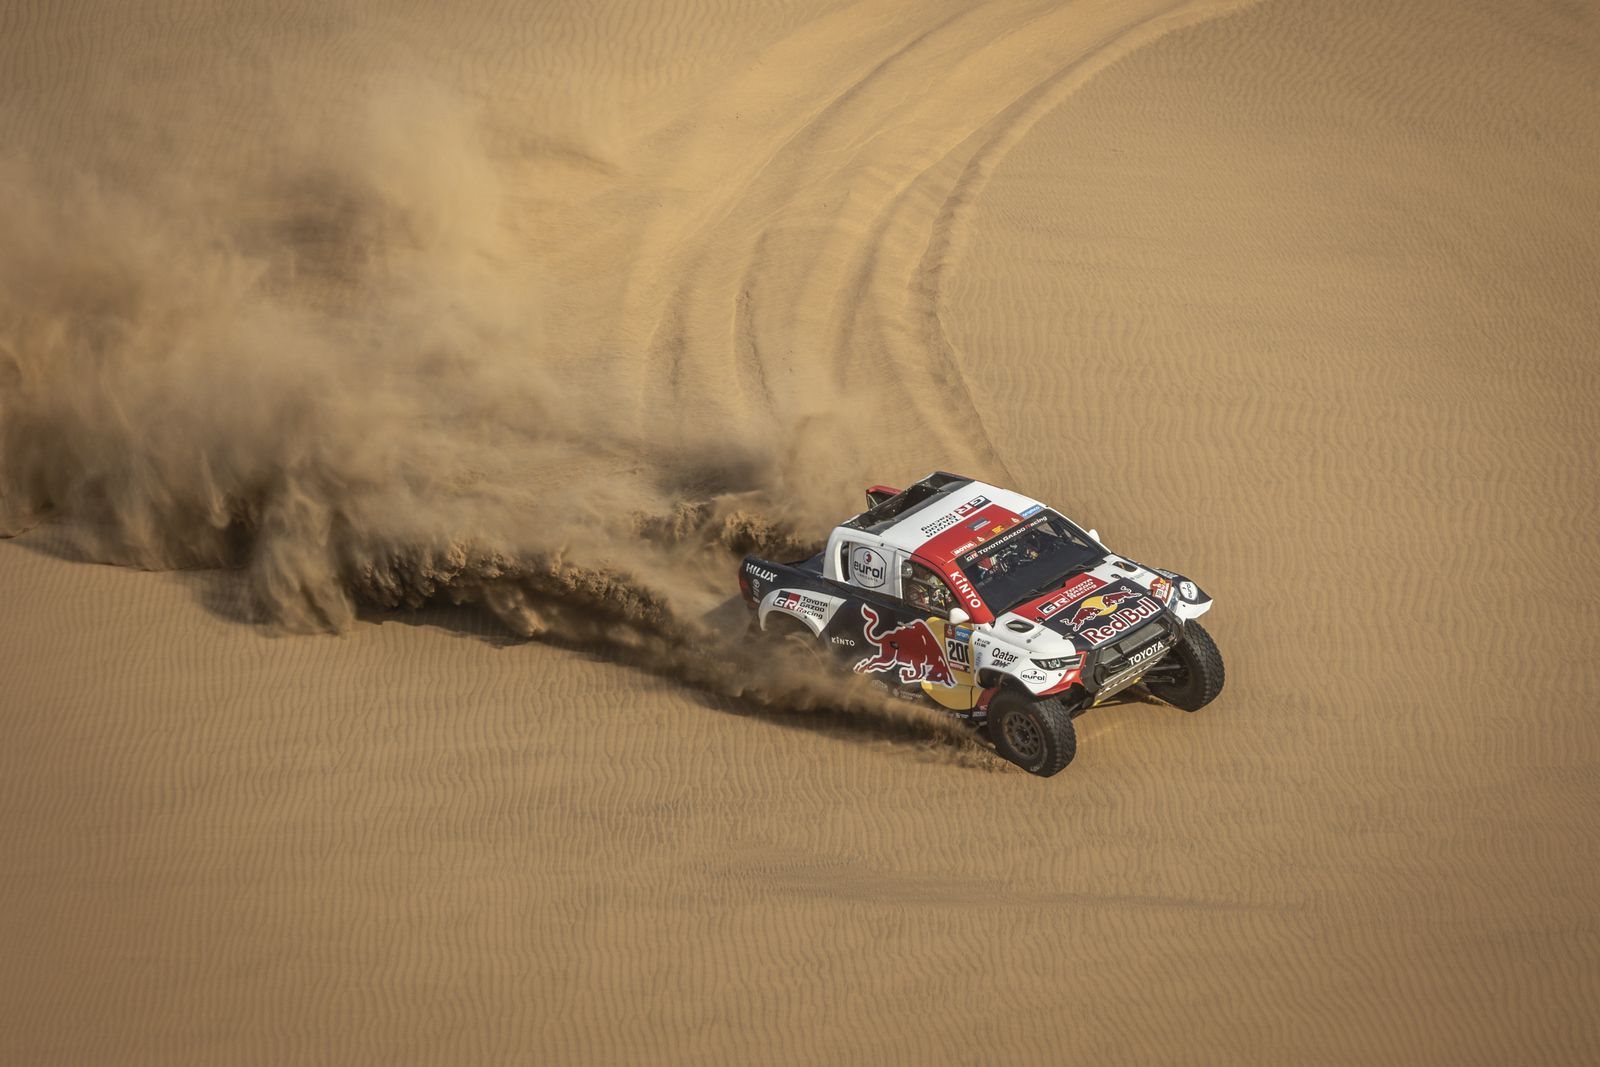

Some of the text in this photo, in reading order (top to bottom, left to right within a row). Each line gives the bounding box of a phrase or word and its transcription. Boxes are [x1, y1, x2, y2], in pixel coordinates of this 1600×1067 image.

[953, 542, 975, 555] MOTUL
[978, 539, 1004, 555] TOYOTA
[1003, 527, 1026, 541] GAZOO
[746, 562, 778, 582] HILUX
[854, 561, 883, 579] eurol
[1063, 578, 1093, 594] TOYOTA
[1070, 584, 1097, 600] Racing
[774, 596, 798, 610] GR
[800, 602, 825, 612] GAZOO
[802, 596, 828, 607] TOYOTA
[1042, 597, 1068, 614] GR
[796, 607, 823, 620] Racing
[992, 647, 1019, 663] Qatar
[1129, 641, 1164, 665] TOYOTA
